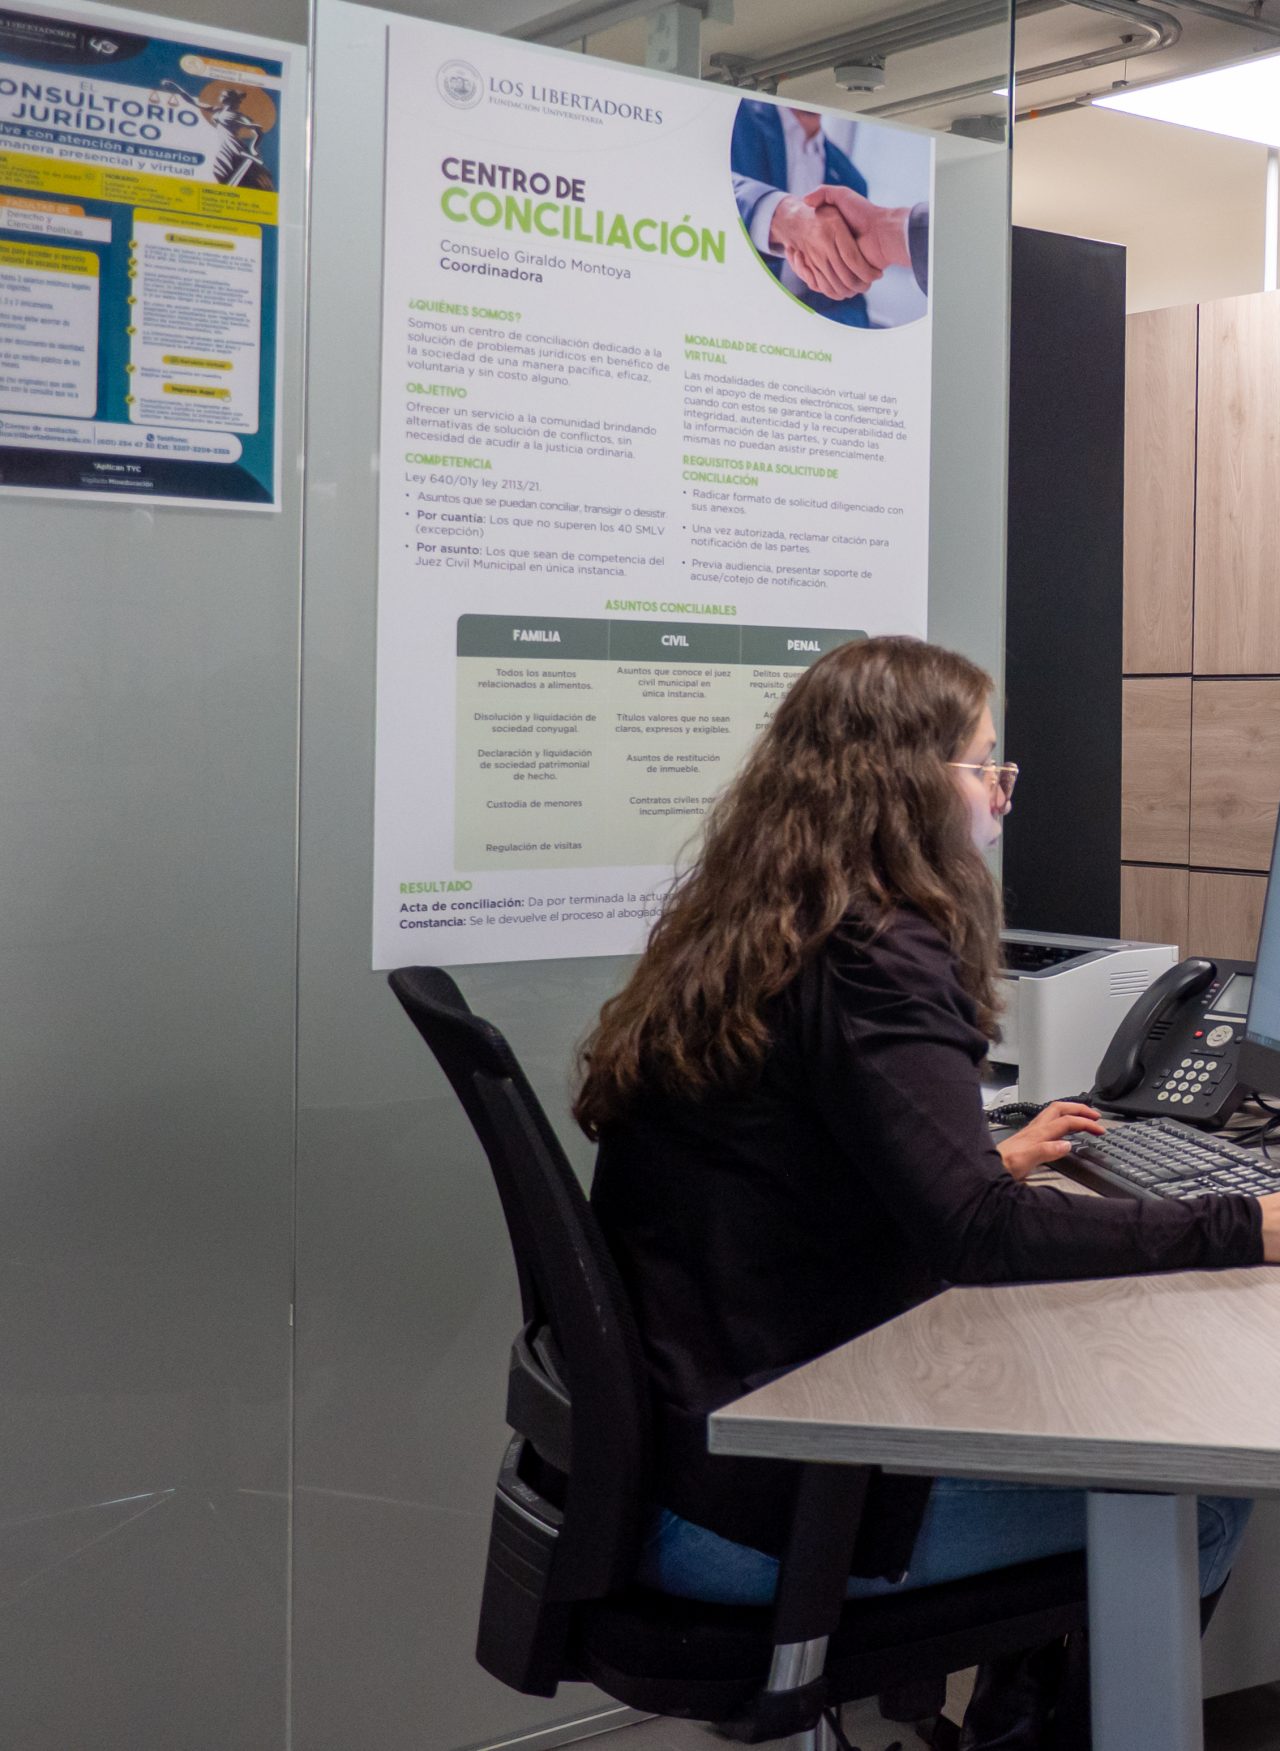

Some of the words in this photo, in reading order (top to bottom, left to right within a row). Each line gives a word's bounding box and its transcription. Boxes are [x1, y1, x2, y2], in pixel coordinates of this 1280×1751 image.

[80, 81, 94, 92] EL
[490, 77, 524, 98] LOS
[532, 86, 663, 124] LIBERTADORES
[12, 103, 162, 141] JURÍDICO
[26, 130, 53, 142] con
[58, 133, 122, 152] atención
[126, 144, 134, 153] a
[138, 146, 199, 164] usuarios
[59, 148, 133, 167] presencial
[138, 161, 146, 171] y
[151, 161, 195, 177] virtual
[442, 157, 550, 195] CENTRO
[556, 176, 586, 202] DE
[441, 186, 726, 264] CONCILIACIÓN
[440, 239, 510, 261] Consuelo
[514, 249, 566, 269] Giraldo
[571, 260, 632, 280] Montoya
[440, 258, 543, 283] Coordinadora
[472, 307, 522, 320] SOMOS?
[408, 317, 448, 332] Somos
[450, 325, 466, 333] un
[468, 327, 506, 339] centro
[508, 331, 523, 341] de
[525, 334, 590, 348] conciliación
[592, 342, 642, 355] dedicado
[644, 349, 651, 357] a
[653, 348, 663, 358] la
[408, 333, 456, 346] solución
[459, 338, 474, 348] de
[476, 342, 536, 355] problemas
[590, 355, 604, 363] en
[656, 362, 671, 372] de
[684, 335, 745, 351] MODALIDAD
[745, 342, 758, 353] DE
[759, 345, 833, 361] CONCILIACIÓN
[684, 350, 728, 364] VIRTUAL
[407, 345, 418, 355] la
[422, 349, 476, 362] sociedad
[479, 354, 494, 364] de
[497, 358, 519, 367] una
[522, 361, 565, 372] manera
[407, 361, 465, 374] voluntaria
[468, 368, 475, 378] y
[478, 368, 495, 377] sin
[497, 371, 529, 381] costo
[406, 383, 468, 397] OBJETIVO
[684, 370, 702, 381] Las
[703, 374, 766, 388] modalidades
[767, 380, 780, 390] de
[782, 384, 836, 396] conciliación
[838, 391, 867, 400] virtual
[868, 394, 879, 402] se
[880, 395, 898, 404] dan
[405, 453, 492, 469] COMPETENCIA
[683, 455, 744, 470] REQUISITOS
[746, 462, 772, 472] PARA
[776, 464, 825, 478] SOLICITUD
[827, 469, 838, 479] DE
[405, 472, 427, 484] Ley
[482, 478, 498, 490] ley
[682, 471, 759, 486] CONCILIACIÓN
[692, 489, 731, 500] Radicar
[733, 492, 772, 504] formato
[774, 497, 787, 505] de
[789, 498, 829, 509] solicitud
[830, 502, 886, 513] diligenciado
[887, 507, 904, 515] con
[415, 524, 485, 538] (excepción)
[417, 510, 438, 520] Por
[490, 516, 510, 525] Los
[513, 519, 534, 527] que
[537, 520, 551, 528] no
[554, 521, 597, 530] superen
[600, 522, 615, 532] los
[618, 524, 633, 533] 40
[636, 525, 665, 535] SMLV
[416, 542, 437, 552] Por
[440, 546, 483, 555] asunto:
[486, 546, 506, 556] Los
[509, 550, 530, 558] que
[533, 551, 559, 559] sean
[561, 551, 575, 560] de
[578, 554, 647, 564] competencia
[649, 557, 665, 566] del
[415, 556, 442, 567] Juez
[445, 557, 470, 568] Civil
[473, 559, 527, 571] Municipal
[529, 564, 543, 572] en
[605, 600, 658, 612] ASUNTOS
[660, 603, 738, 615] CONCILIABLES
[513, 629, 561, 642] FAMILIA
[661, 635, 690, 646] CIVIL
[787, 640, 821, 652] PENAL
[496, 668, 524, 677] Todos
[526, 669, 540, 677] los
[617, 667, 652, 675] Asuntos
[654, 669, 670, 677] que
[714, 670, 732, 678] juez
[753, 670, 780, 678] Delitos
[478, 680, 538, 688] relacionados
[750, 681, 784, 690] requisito
[486, 800, 528, 808] Custodia
[530, 800, 542, 808] de
[400, 881, 473, 893] RESULTADO
[400, 903, 428, 912] Acta
[432, 901, 448, 911] de
[450, 898, 525, 910] conciliación:
[528, 897, 544, 907] Da
[547, 898, 566, 906] por
[569, 894, 624, 904] terminada
[627, 893, 637, 902] la
[399, 917, 467, 929] Constancia:
[470, 916, 484, 926] Se
[486, 916, 496, 925] le
[499, 914, 547, 924] devuelve
[550, 912, 559, 921] el
[562, 912, 604, 921] proceso
[606, 909, 616, 918] al
